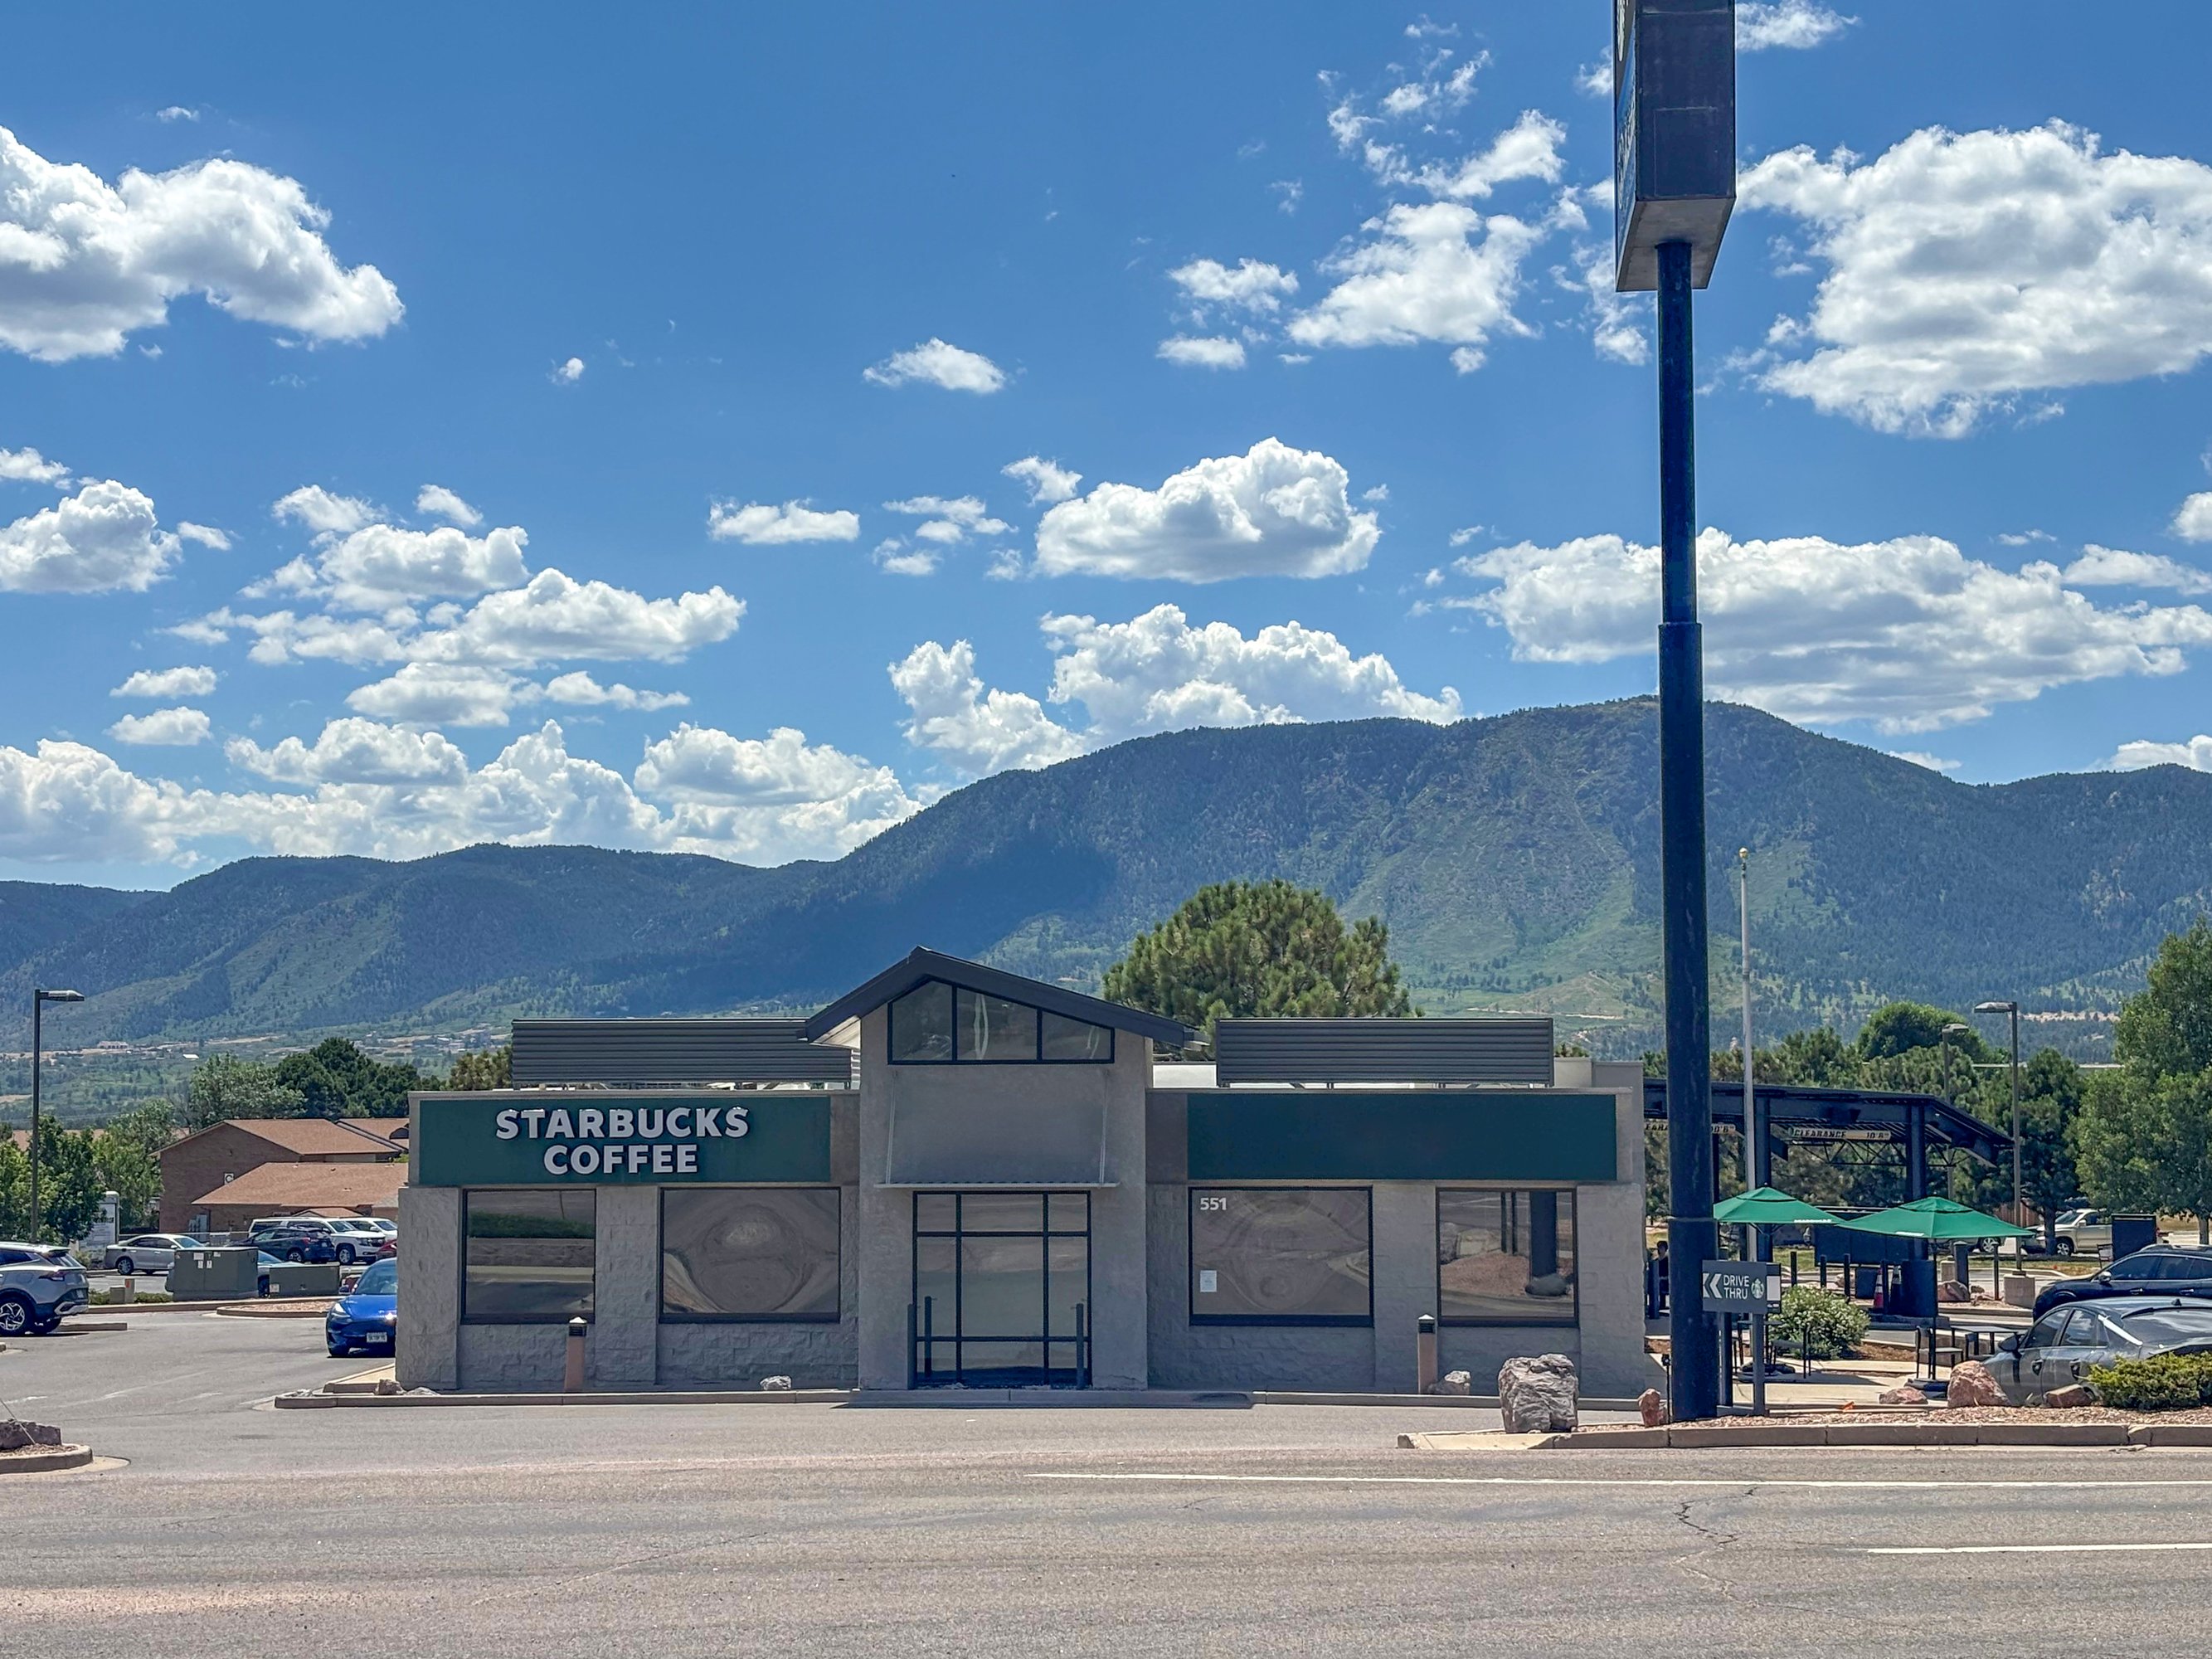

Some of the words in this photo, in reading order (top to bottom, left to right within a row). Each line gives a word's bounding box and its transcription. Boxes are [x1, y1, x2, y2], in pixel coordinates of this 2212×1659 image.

[496, 1107, 750, 1139] STARBUCKS
[1793, 1128, 1846, 1137] CLEARANCE
[544, 1144, 698, 1175] COFFEE
[1200, 1197, 1227, 1210] 551
[1723, 1275, 1750, 1287] DRIVE
[1723, 1287, 1748, 1300] THRU
